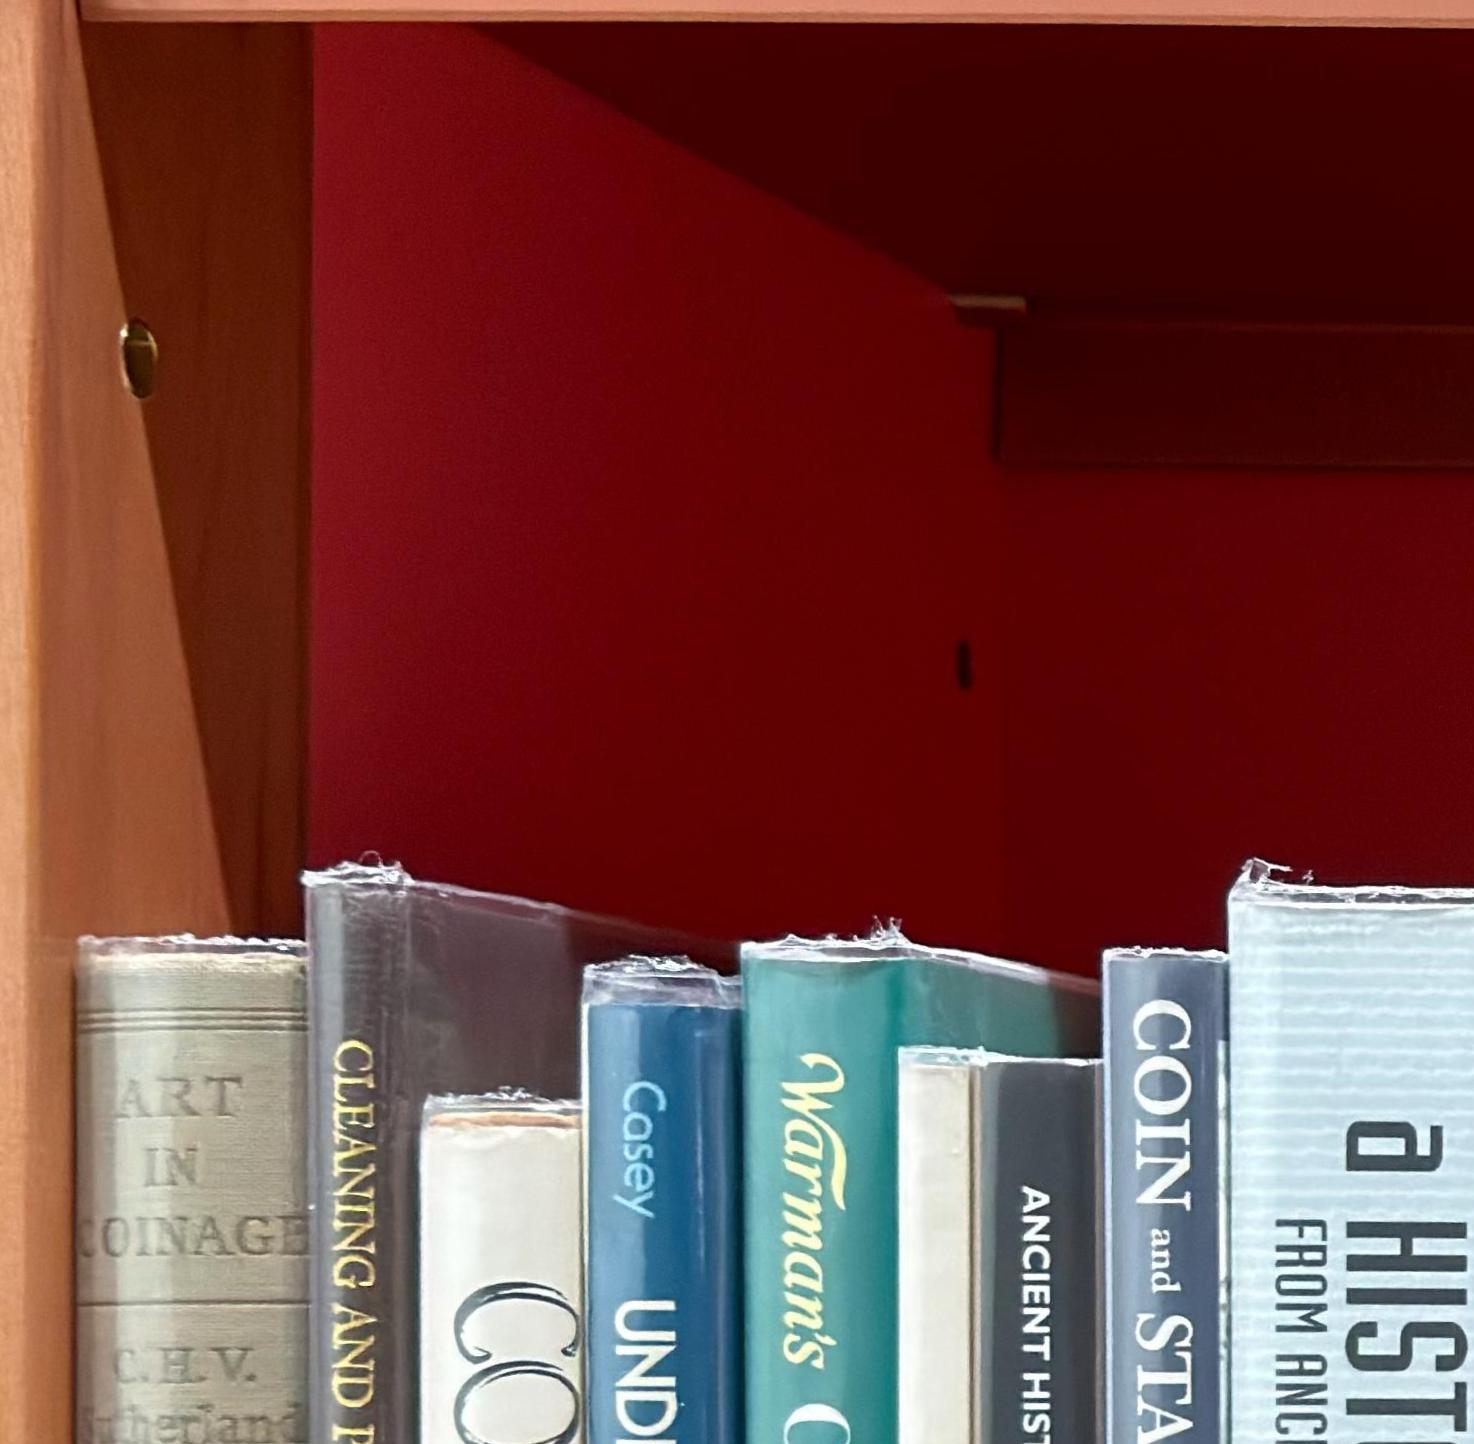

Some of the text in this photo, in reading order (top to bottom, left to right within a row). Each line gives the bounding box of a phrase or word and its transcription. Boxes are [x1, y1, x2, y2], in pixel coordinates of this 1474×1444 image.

[115, 1077, 243, 1118] ART
[613, 1080, 666, 1219] Casey
[1132, 999, 1192, 1212] COIN
[143, 1148, 198, 1186] IN
[331, 1040, 376, 1289] CLEANING
[779, 1053, 846, 1370] Warman's
[1021, 1186, 1052, 1360] ANCIENT
[1150, 1229, 1181, 1295] and
[1274, 1219, 1328, 1333] FROM
[331, 1305, 377, 1409] AND
